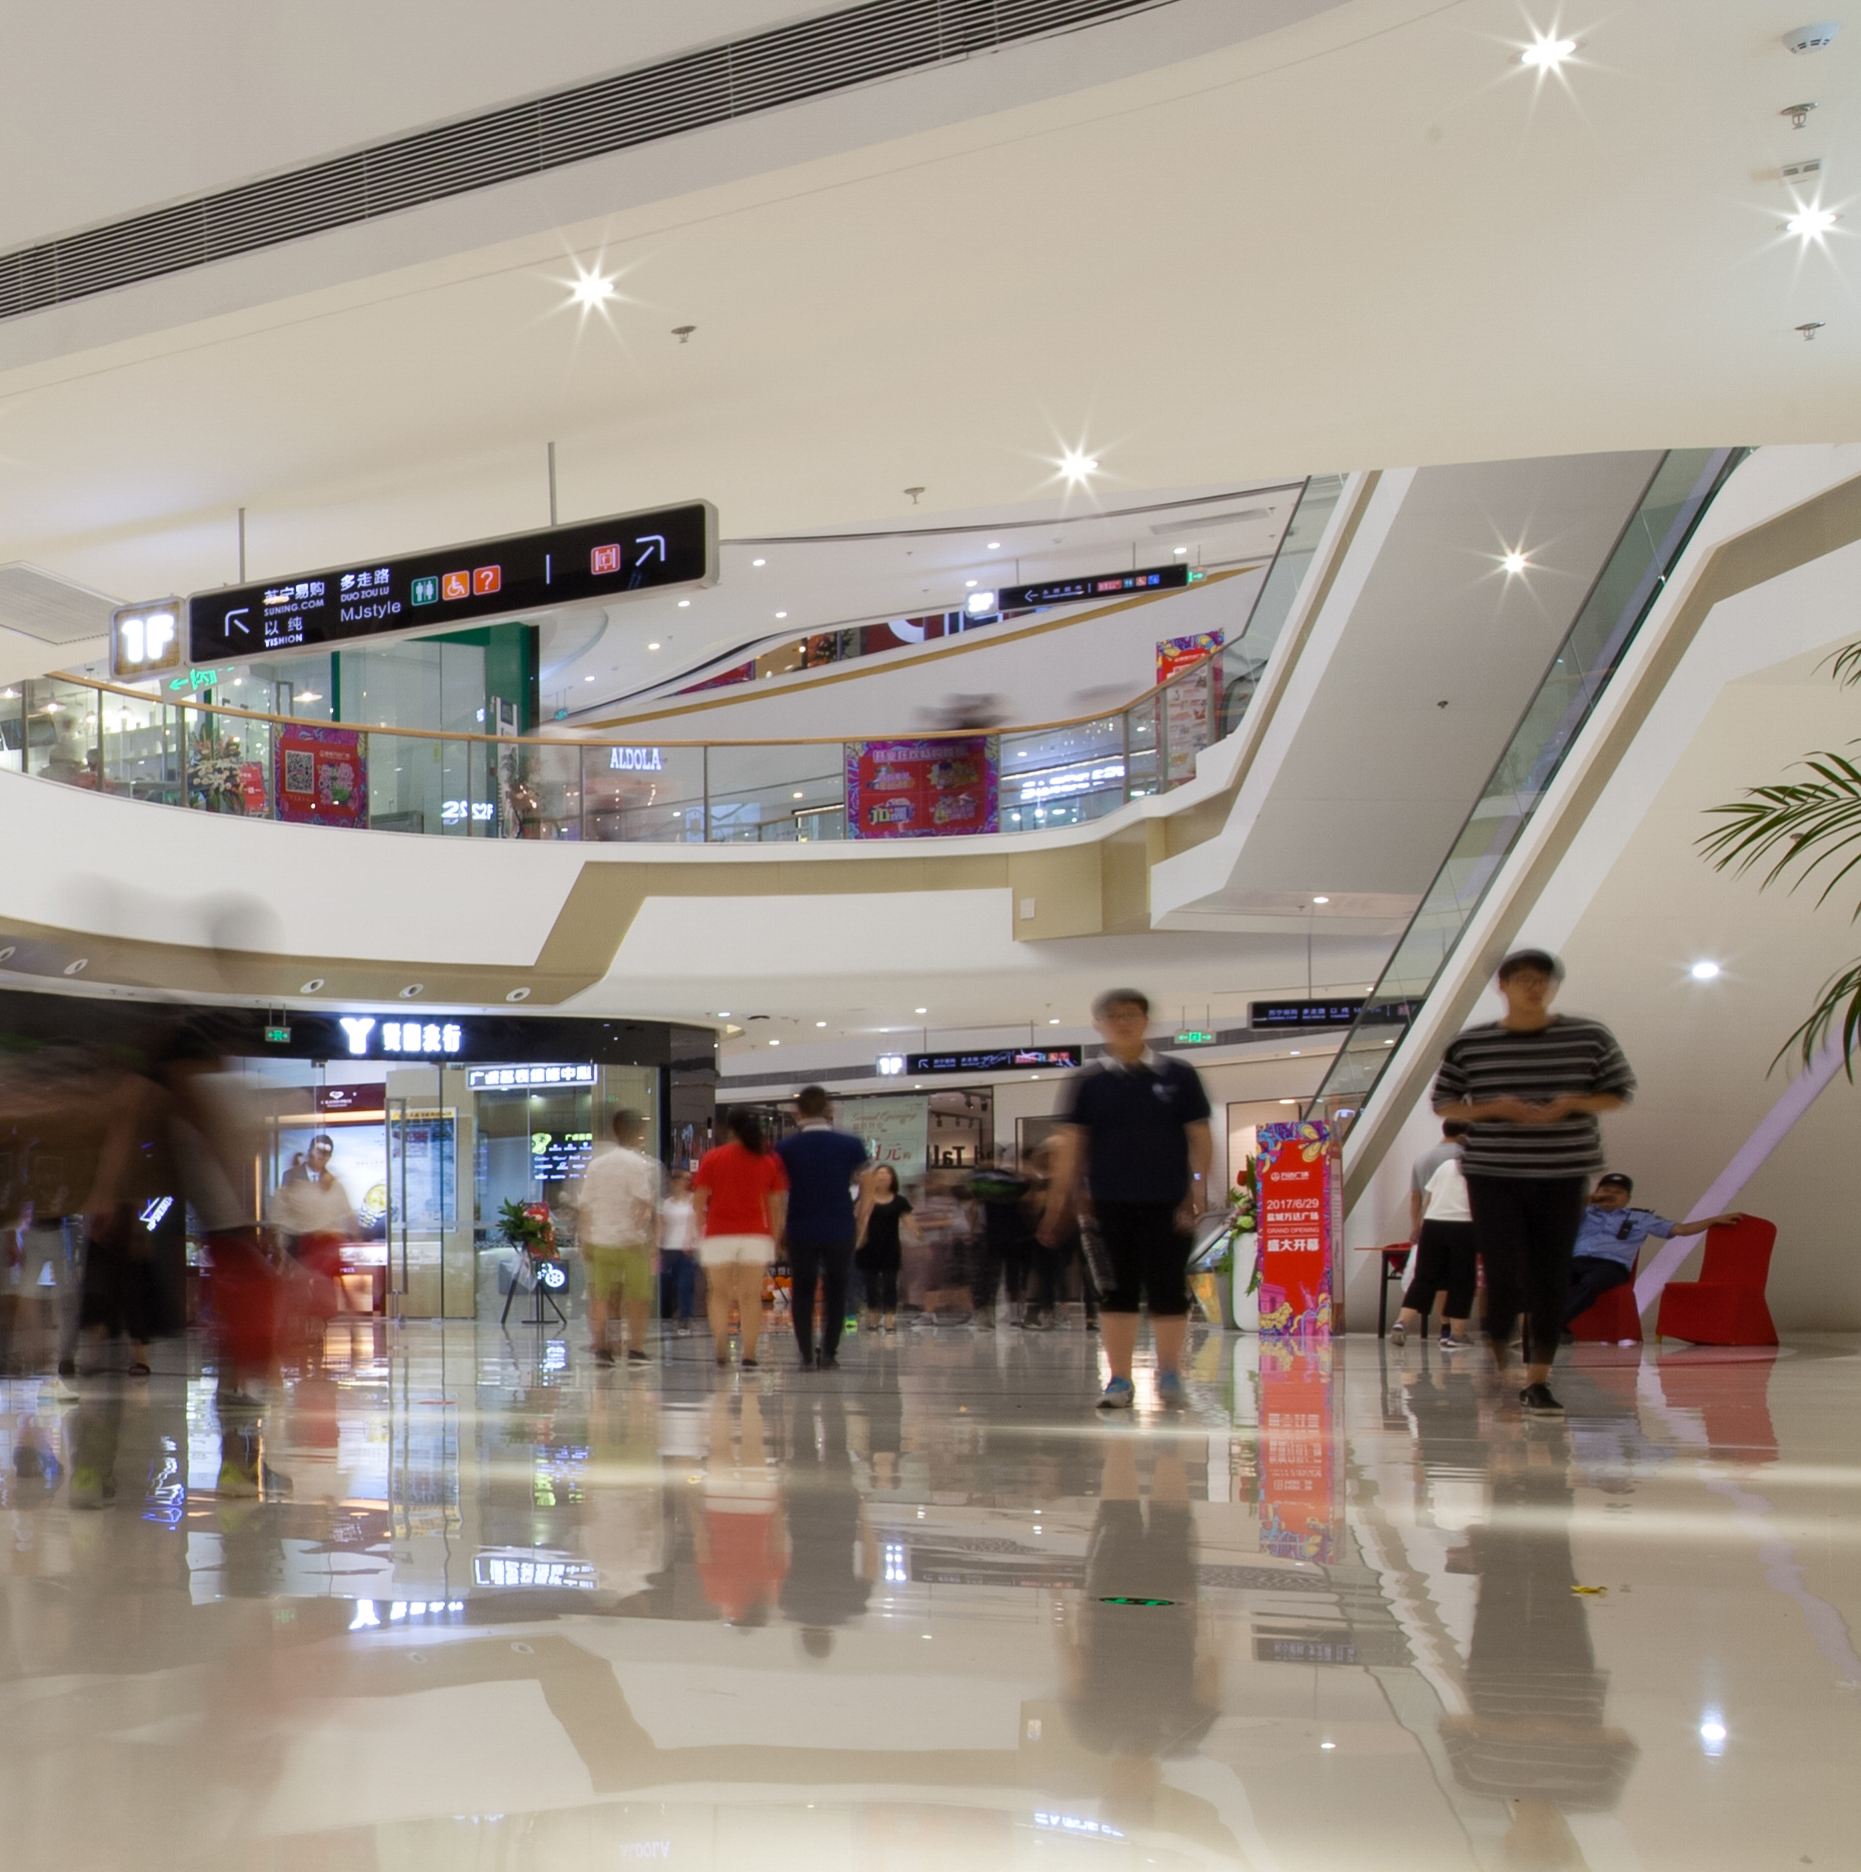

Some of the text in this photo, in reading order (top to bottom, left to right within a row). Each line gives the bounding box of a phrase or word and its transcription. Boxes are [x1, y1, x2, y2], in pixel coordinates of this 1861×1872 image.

[341, 569, 389, 591] 多走路
[264, 582, 325, 605] 苏宁易购
[341, 587, 389, 603] DUO ZOU LU
[264, 599, 325, 617] SUNING.COM
[341, 601, 400, 622] MJstyle
[121, 615, 174, 662] 1F
[265, 634, 303, 647] YISHION
[610, 748, 661, 770] ALDOLA
[1267, 1199, 1319, 1210] 2017/6/29
